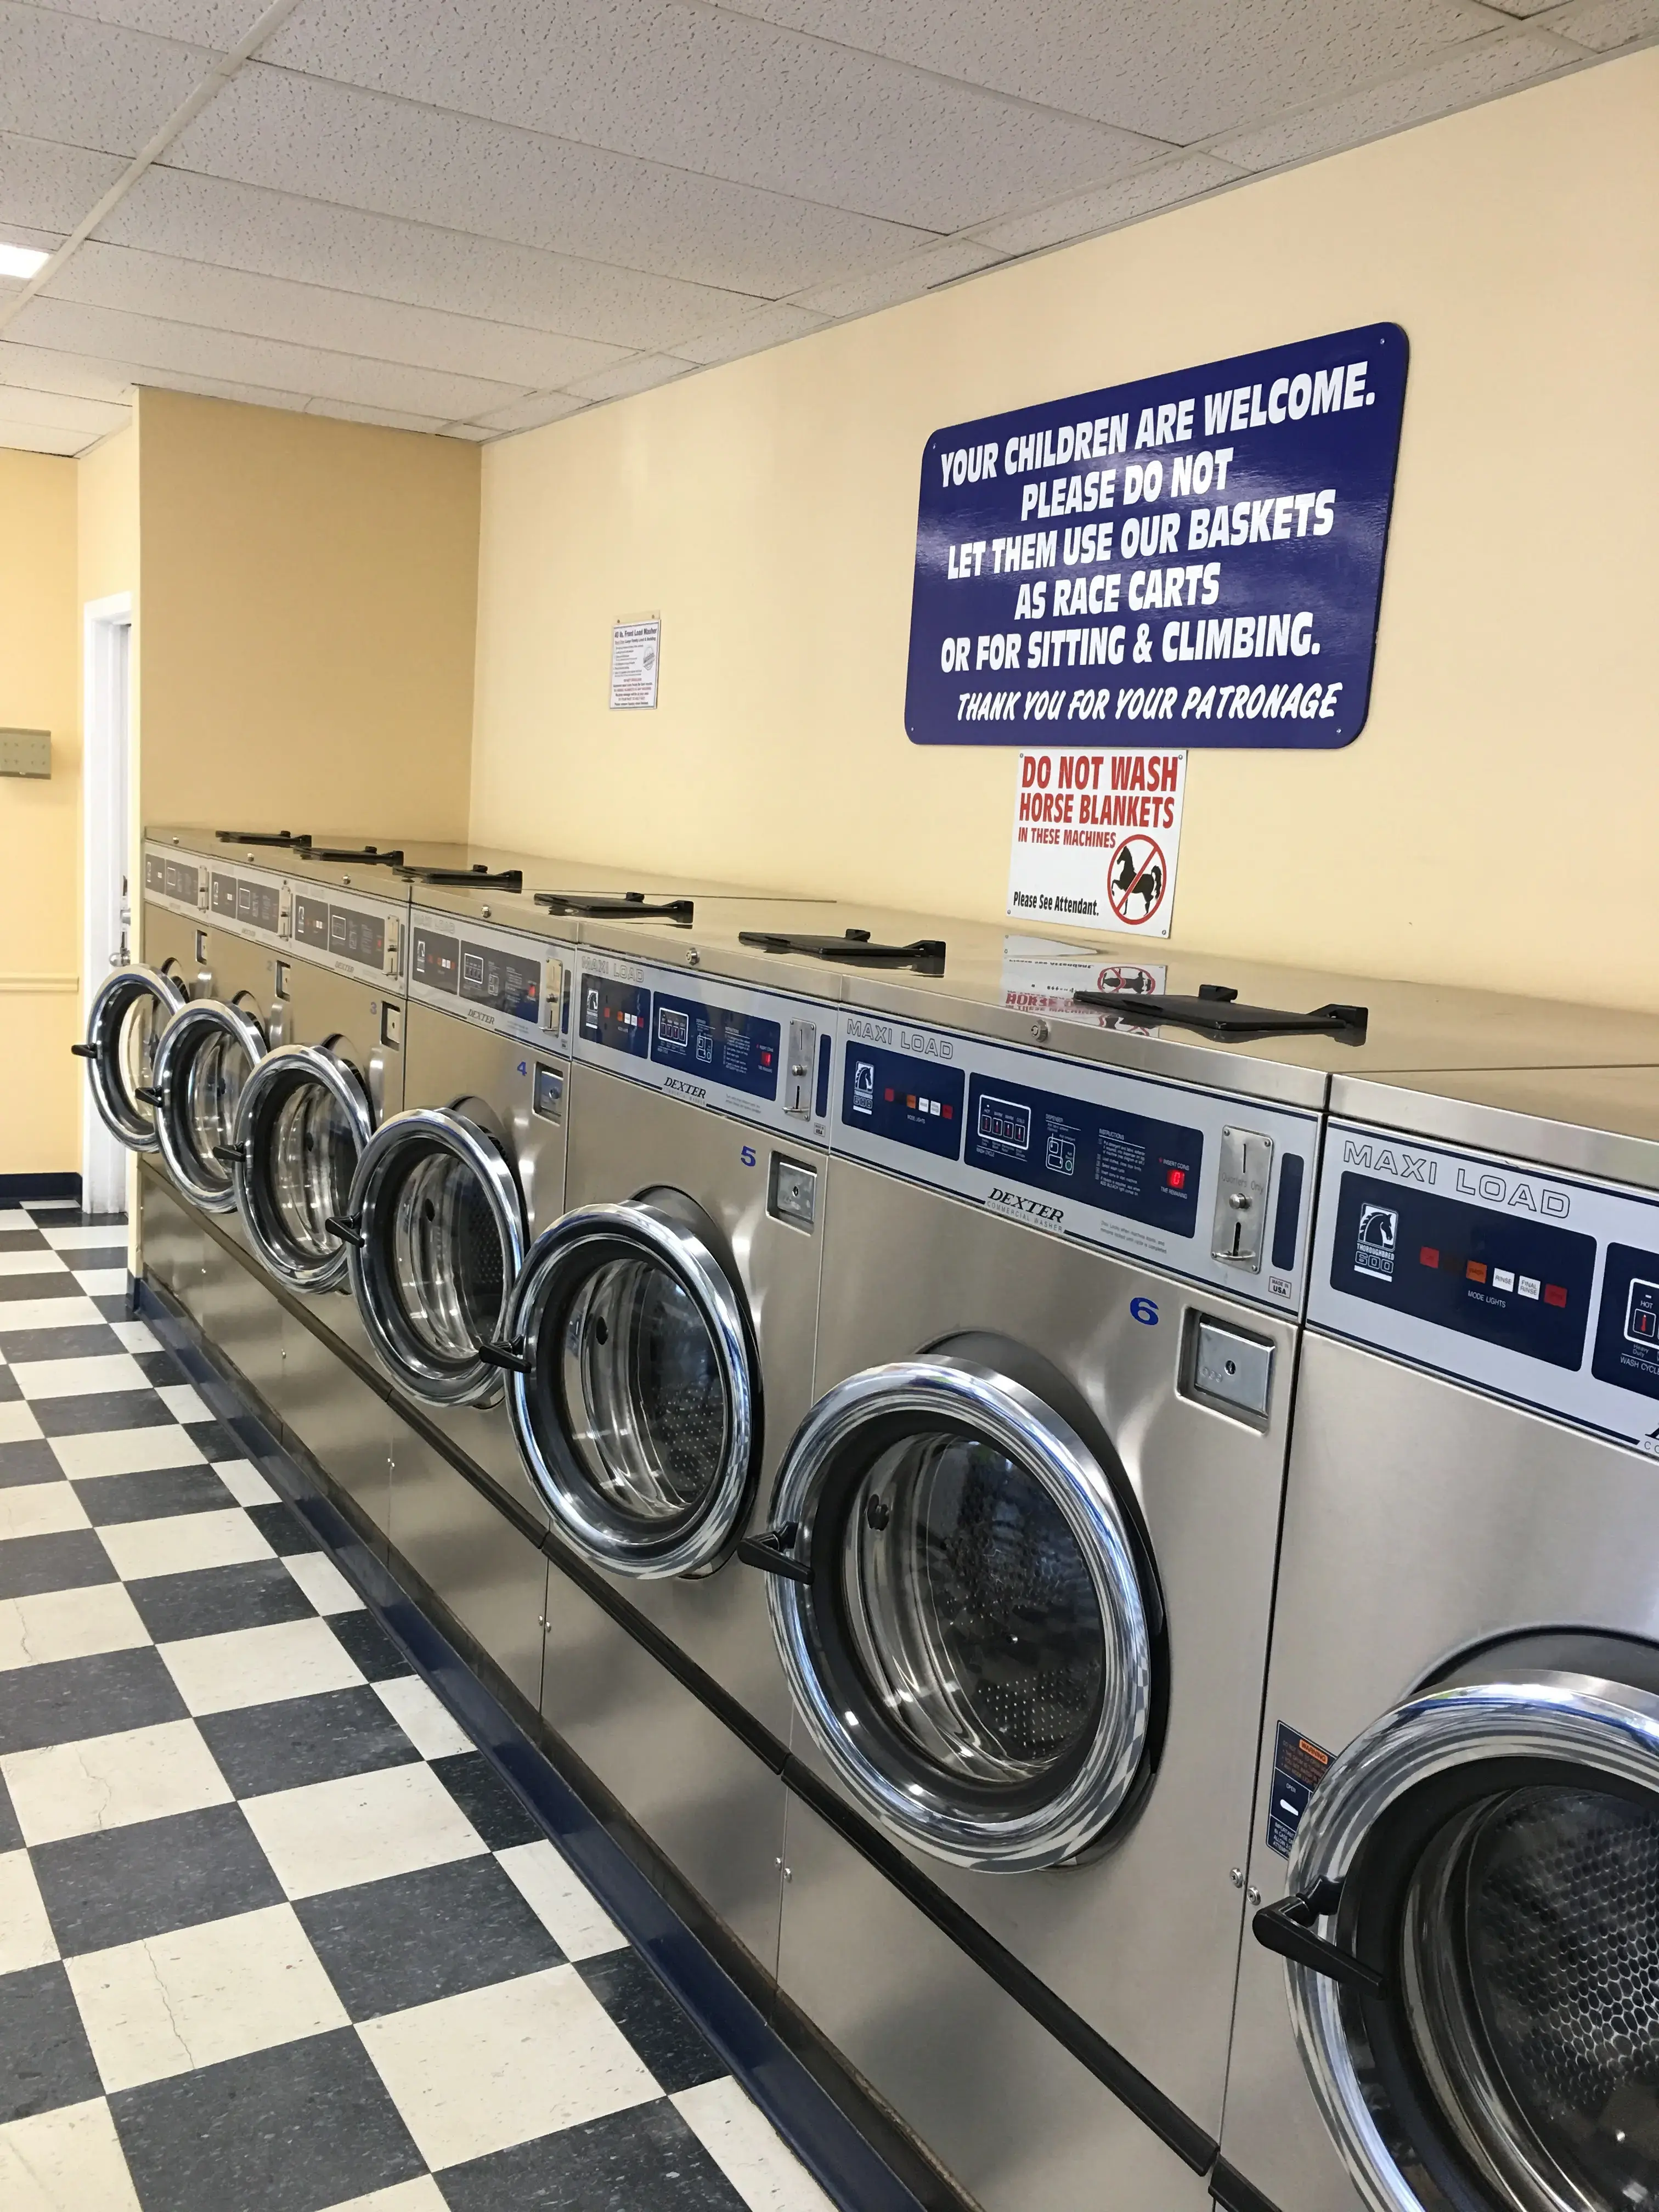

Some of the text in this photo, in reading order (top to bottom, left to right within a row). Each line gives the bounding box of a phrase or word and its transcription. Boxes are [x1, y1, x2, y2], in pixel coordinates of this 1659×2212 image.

[941, 362, 1374, 487] YOUR CHILDREN ARE WELCOME.
[1022, 448, 1233, 521] PLEASE DO NOT
[948, 489, 1335, 579] LET THEM USE OUR BASKETS
[1014, 562, 1221, 620] AS RACE CARTS
[941, 612, 1320, 672] OR FOR SITTING & CLIMBING.
[958, 682, 1342, 720] THANK YOU FOR YOUR PATRONAGE
[1022, 756, 1178, 791] DO NOT WASH
[1020, 793, 1175, 828] HORSE BLANKETS
[1018, 828, 1115, 848] IN THESE MACHINES
[1014, 891, 1098, 916] Please See Attendant.
[582, 956, 644, 983] MAXI LOAD
[370, 1002, 377, 1015] 3
[467, 1008, 495, 1025] DEXTER
[847, 1018, 953, 1060] MAXI LOAD
[517, 1062, 527, 1075] 4
[663, 1076, 707, 1099] DEXTER
[1099, 1128, 1125, 1140] INSTRUCTIONS
[740, 1146, 756, 1167] 5
[1163, 1159, 1189, 1171] INSERT COINS
[1221, 1172, 1263, 1195] Quarters Only
[1344, 1141, 1571, 1219] MAXI LOAD
[1160, 1186, 1188, 1199] TIME REMAINING
[988, 1188, 1064, 1223] DEXTER
[988, 1201, 1063, 1232] COMMERCIAL WASHER
[1355, 1251, 1394, 1274] 600
[1357, 1243, 1395, 1261] THOROUGHBRED
[1272, 1279, 1283, 1287] MADE
[1273, 1285, 1286, 1295] USA
[1495, 1275, 1512, 1285] RINSE
[1520, 1285, 1537, 1296] RINSE
[1521, 1280, 1537, 1290] FINAL
[1468, 1290, 1506, 1308] MODE LIGHTS
[1640, 1300, 1654, 1309] HOT
[1130, 1297, 1159, 1325] 6
[1633, 1344, 1650, 1354] Heavy
[1633, 1348, 1645, 1358] Duty
[1620, 1356, 1640, 1369] WASH
[1301, 1741, 1326, 1762] WARNING
[1286, 1783, 1296, 1793] OPEN
